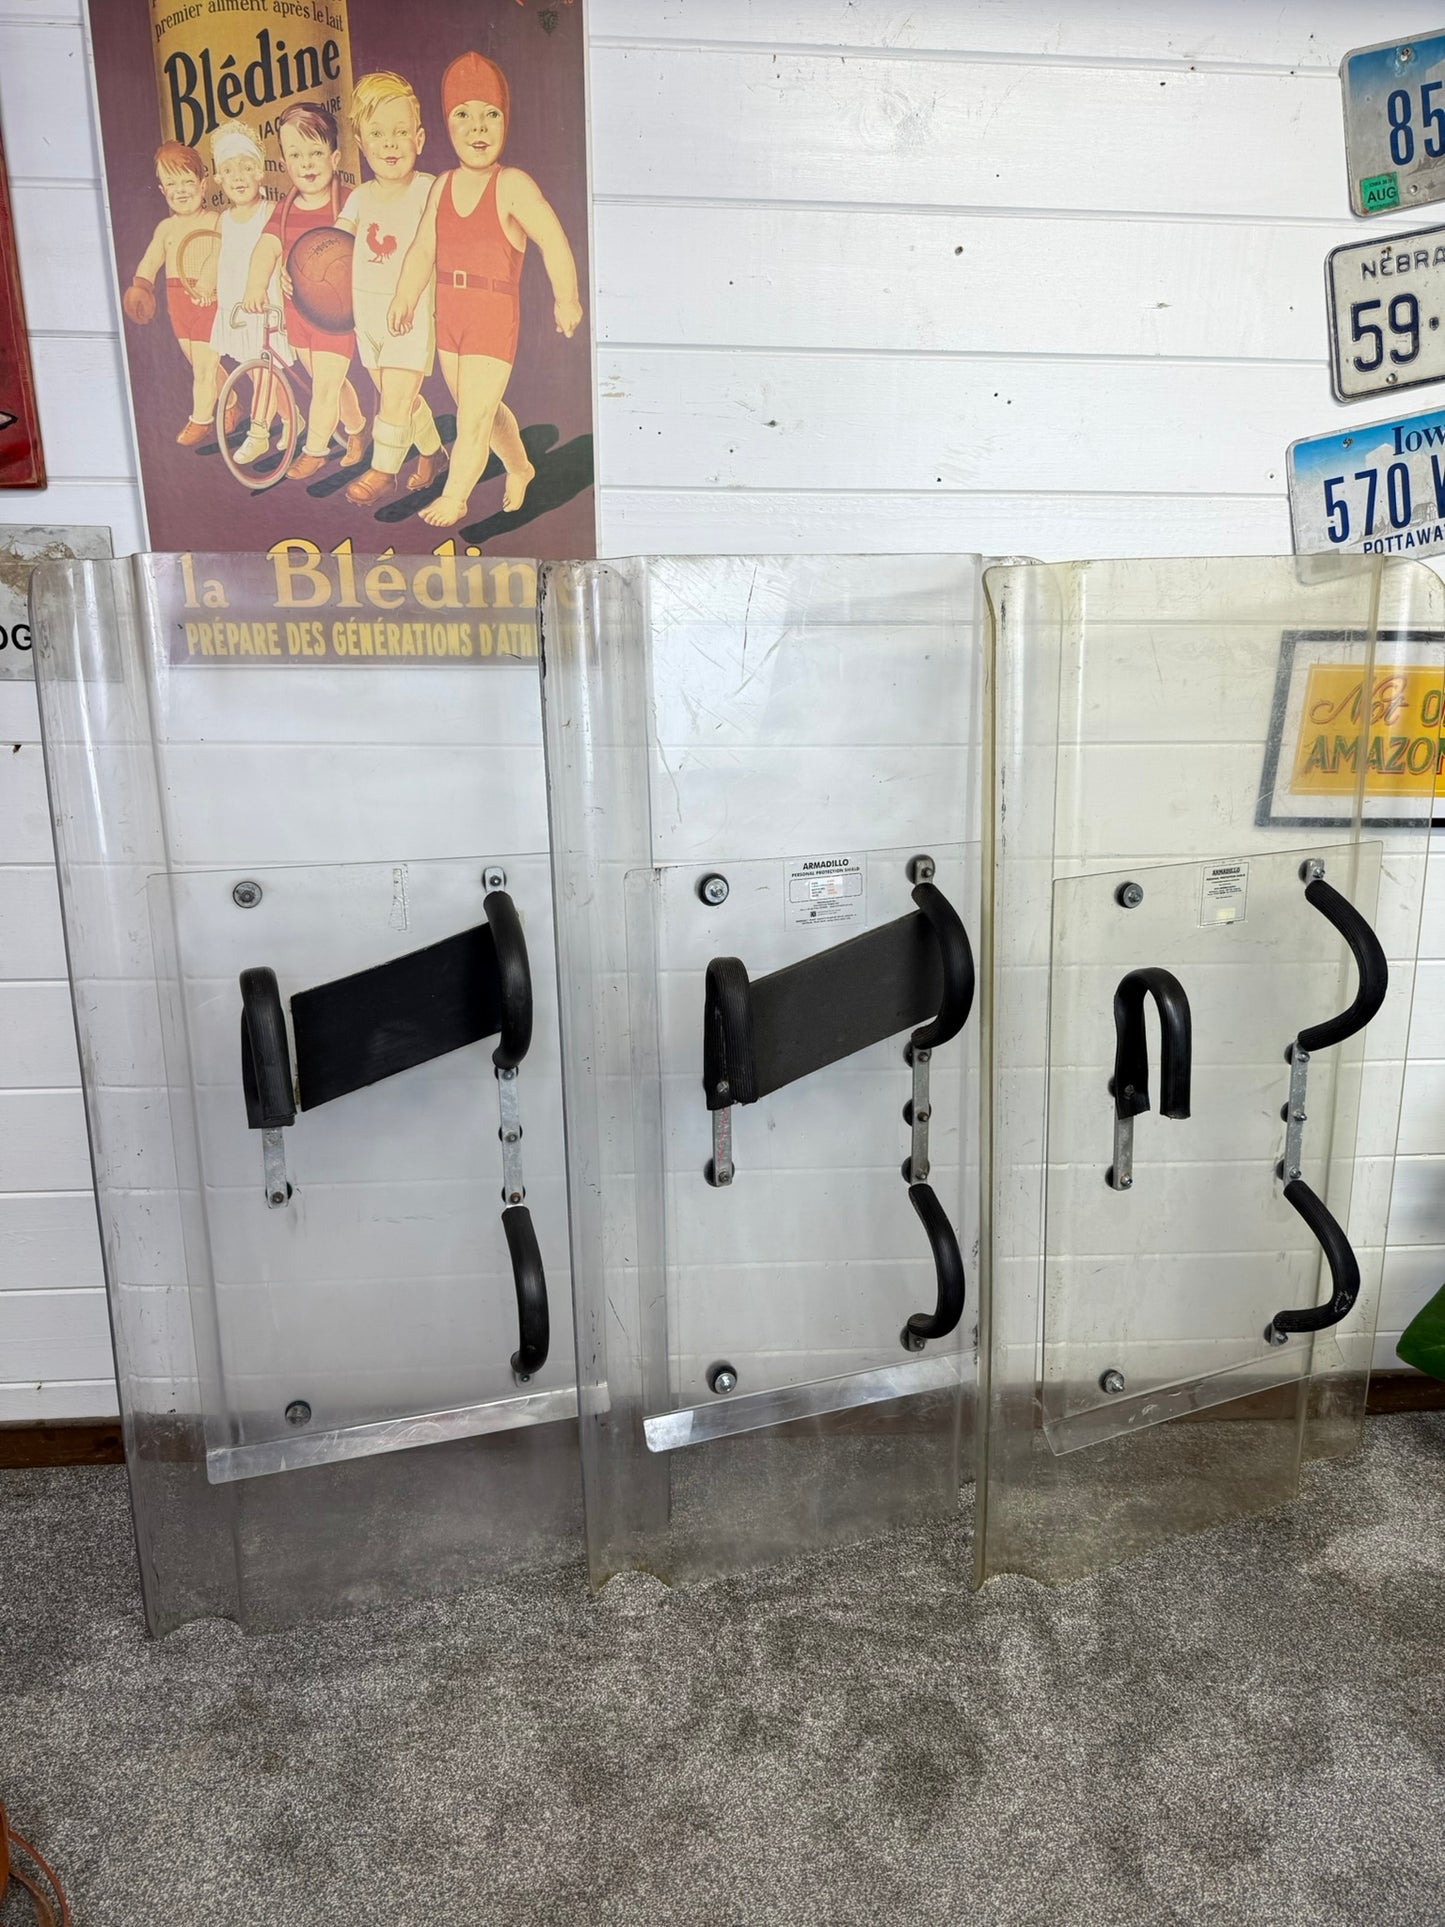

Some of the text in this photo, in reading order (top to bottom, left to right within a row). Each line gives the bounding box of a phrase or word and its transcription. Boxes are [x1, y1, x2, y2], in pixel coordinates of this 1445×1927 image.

[155, 4, 203, 42] premier
[273, 0, 311, 18] après
[313, 1, 324, 23] le
[326, 7, 344, 32] lait
[164, 28, 341, 148] Blédine
[1387, 81, 1445, 166] 85
[1367, 186, 1396, 204] AUG
[1361, 246, 1445, 280] NEBRA
[1350, 293, 1420, 373] 59
[1363, 522, 1445, 554] POTTAWA
[177, 550, 230, 608] la
[184, 617, 539, 656] PRÉPARE DES GÉNÉRATIONS D'ATH
[803, 859, 849, 870] ARMADILLO
